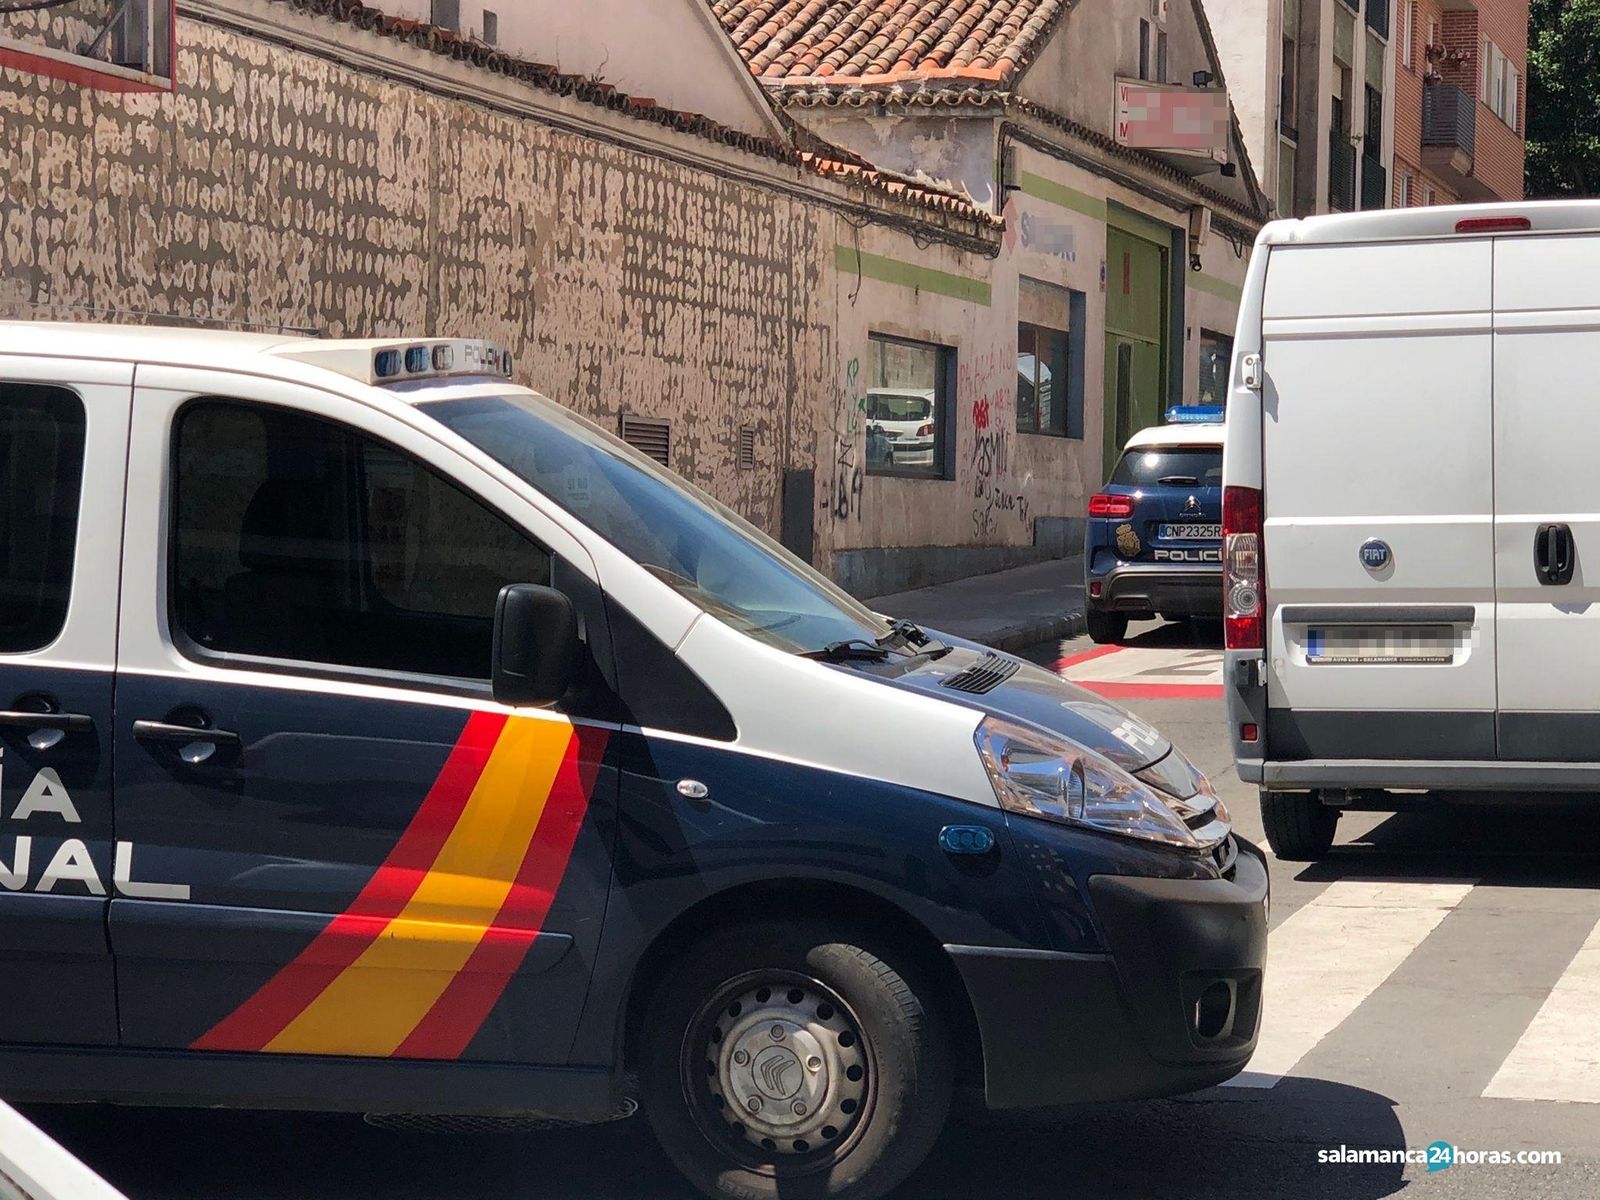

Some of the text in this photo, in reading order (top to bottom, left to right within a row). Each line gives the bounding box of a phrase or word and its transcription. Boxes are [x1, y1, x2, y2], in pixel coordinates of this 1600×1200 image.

[1165, 525, 1223, 537] CNP2325R
[1364, 549, 1386, 560] FIAT
[0, 747, 82, 823] A
